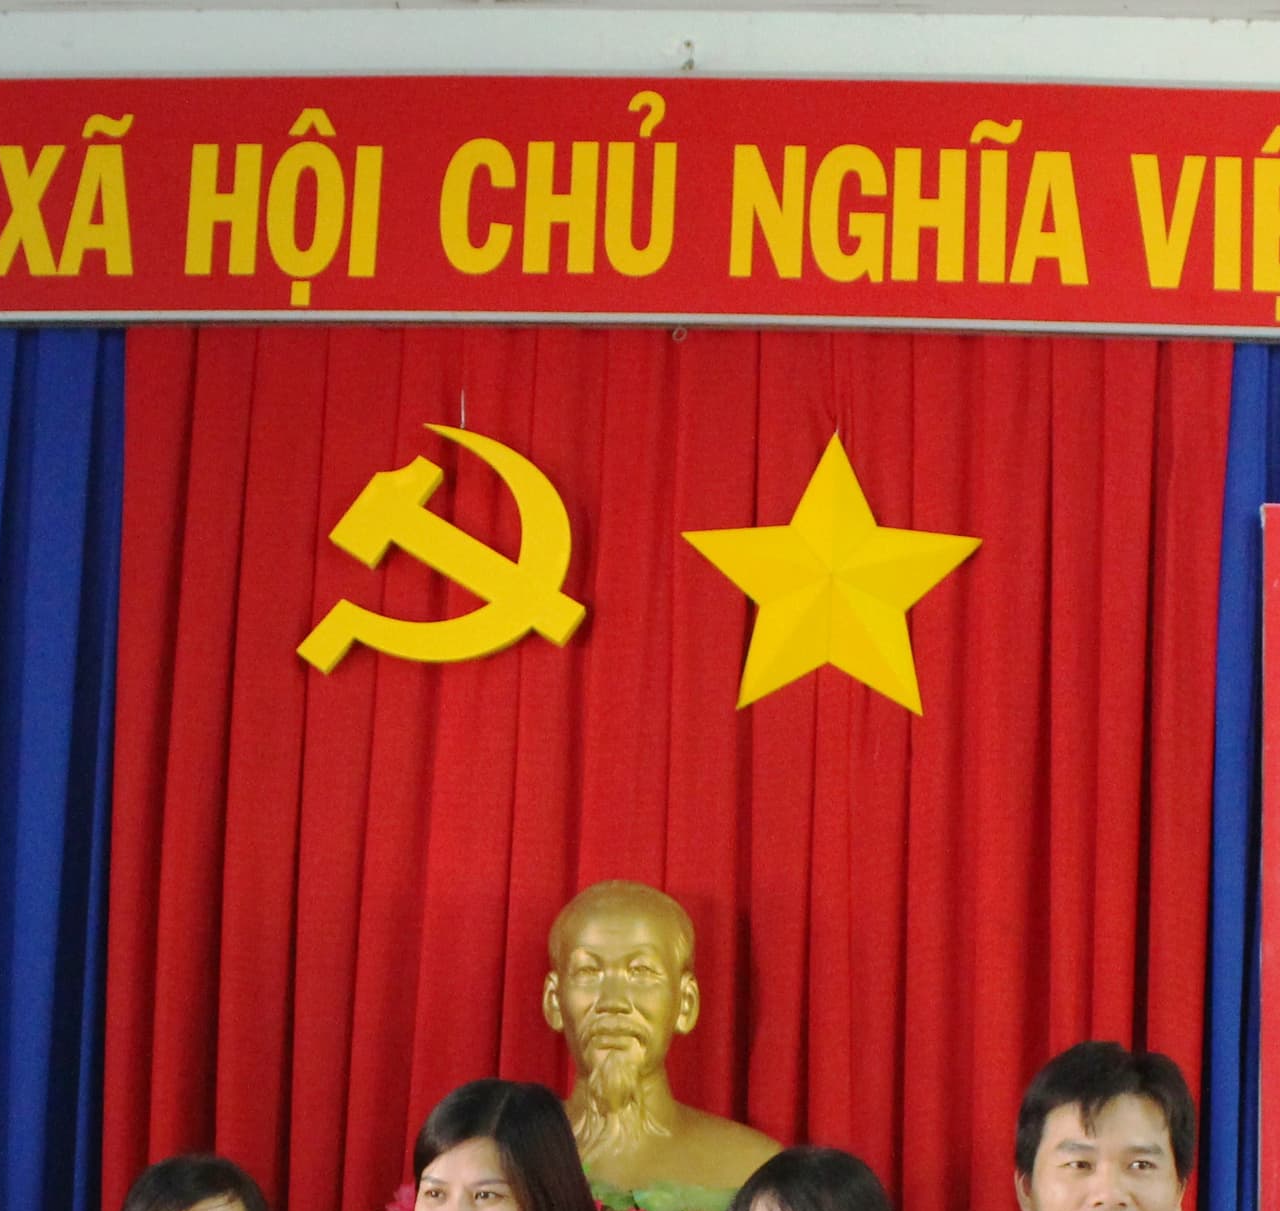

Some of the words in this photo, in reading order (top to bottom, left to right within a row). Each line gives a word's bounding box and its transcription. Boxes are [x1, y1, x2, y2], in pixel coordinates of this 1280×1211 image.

[187, 110, 383, 306] HỘI
[440, 90, 677, 277] CHỦ
[731, 122, 1089, 285] NGHĨA
